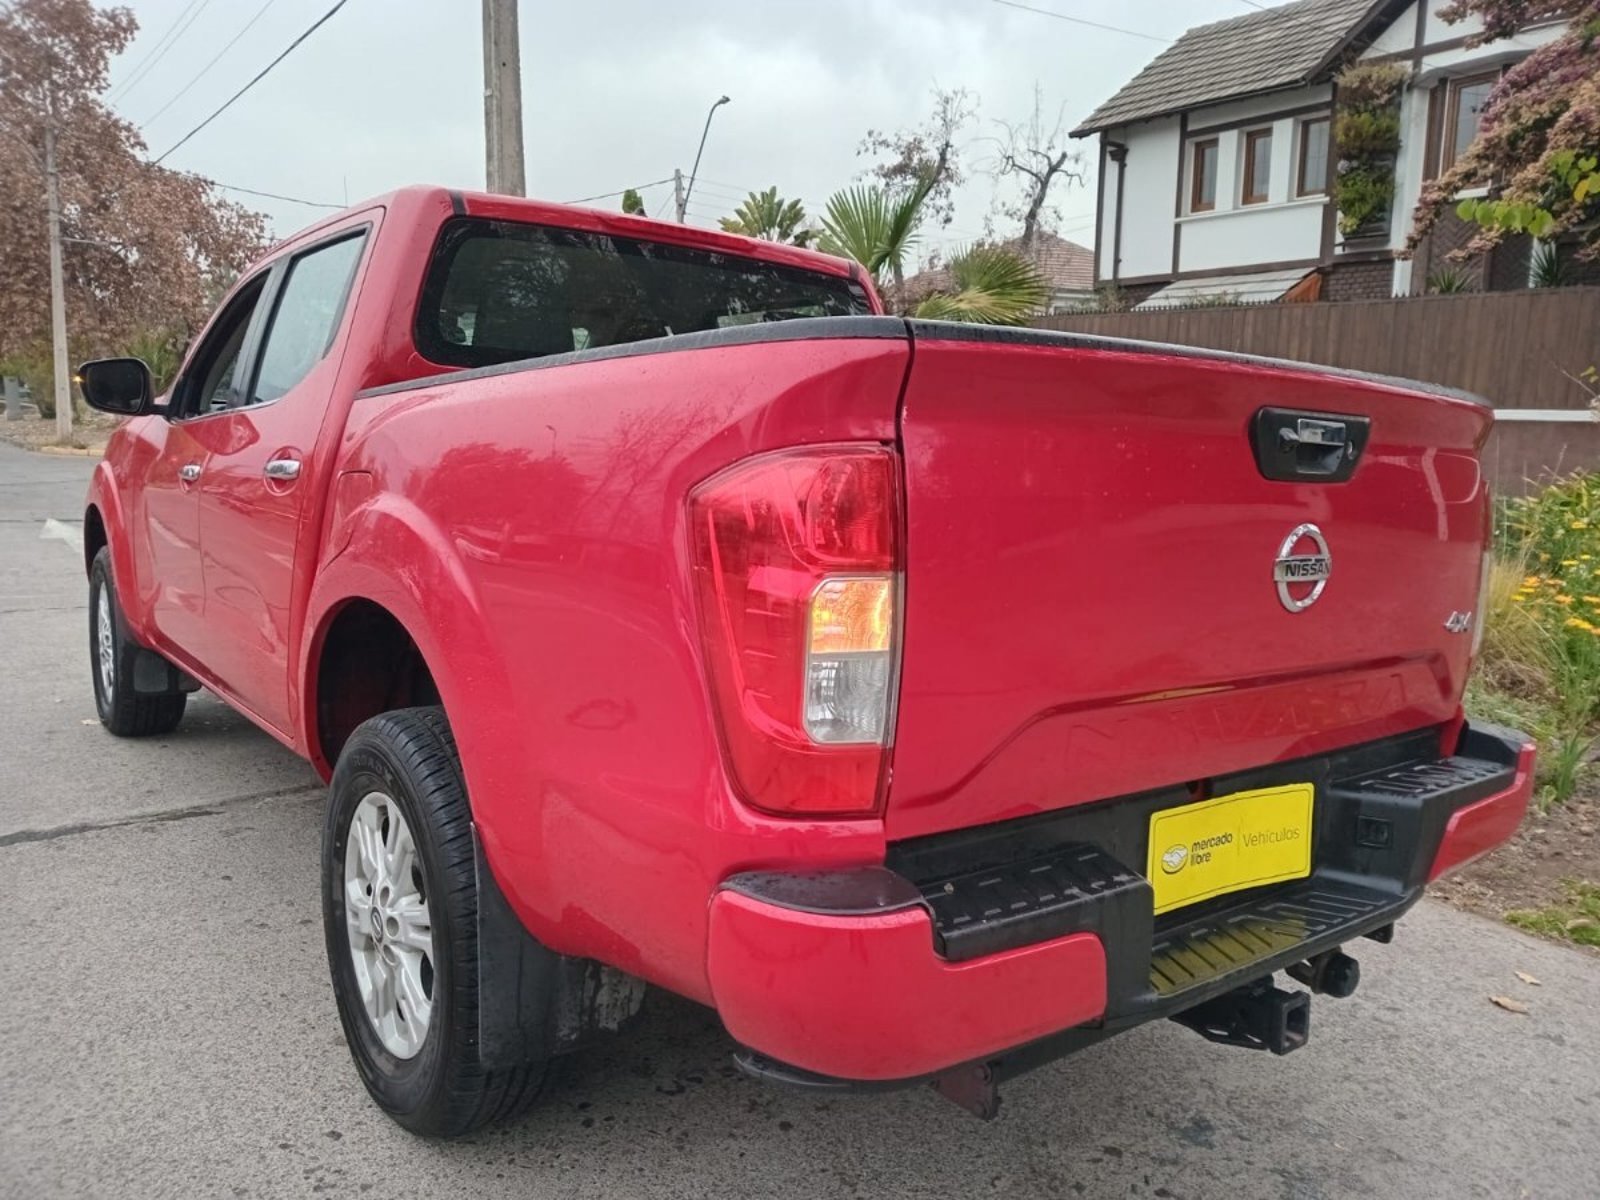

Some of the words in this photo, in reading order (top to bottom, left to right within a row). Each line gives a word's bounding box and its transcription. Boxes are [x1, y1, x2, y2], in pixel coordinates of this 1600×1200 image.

[1285, 562, 1330, 577] NISSAN
[1191, 832, 1233, 852] mercado
[1190, 851, 1212, 866] libre
